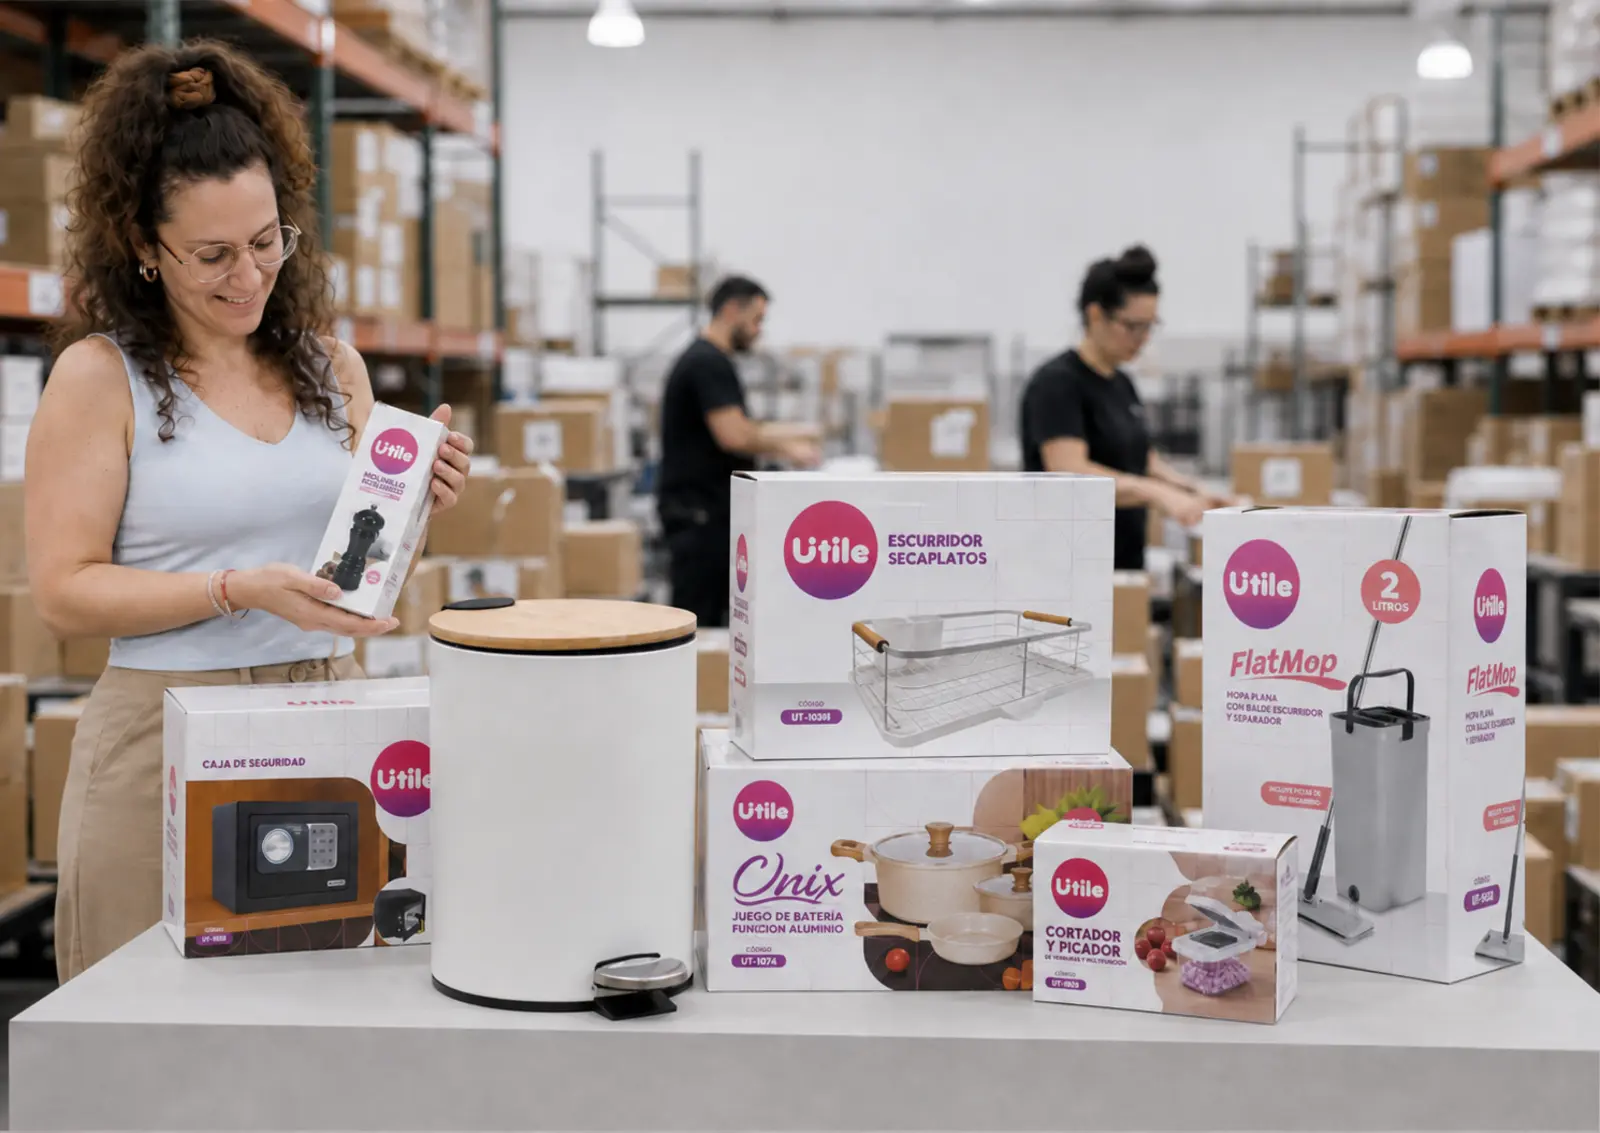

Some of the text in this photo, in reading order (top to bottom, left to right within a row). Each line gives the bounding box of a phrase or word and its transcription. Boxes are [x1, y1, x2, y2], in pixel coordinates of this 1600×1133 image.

[374, 439, 414, 463] Utile
[888, 534, 983, 548] ESCURRIDOR
[792, 536, 870, 565] Utile
[888, 551, 987, 565] SECAPLATOS
[1228, 570, 1293, 598] Utile
[1380, 571, 1399, 599] 2
[1372, 601, 1409, 612] LITROS
[1229, 648, 1338, 678] FlatMop
[1467, 662, 1516, 694] FlatMop
[1226, 713, 1282, 725] Y SEPARADOR
[1273, 706, 1323, 717] ESCURRIDOR
[202, 757, 306, 769] CAJA DE SEGURIDAD
[738, 802, 789, 821] Utile
[733, 852, 845, 901] Onix
[1055, 877, 1104, 899] Utile
[732, 909, 844, 922] JUEGO DE BATERÍA
[789, 924, 844, 934] ALUMINIO
[1045, 925, 1121, 943] CORTADOR
[1046, 940, 1121, 958] Y PICADOR
